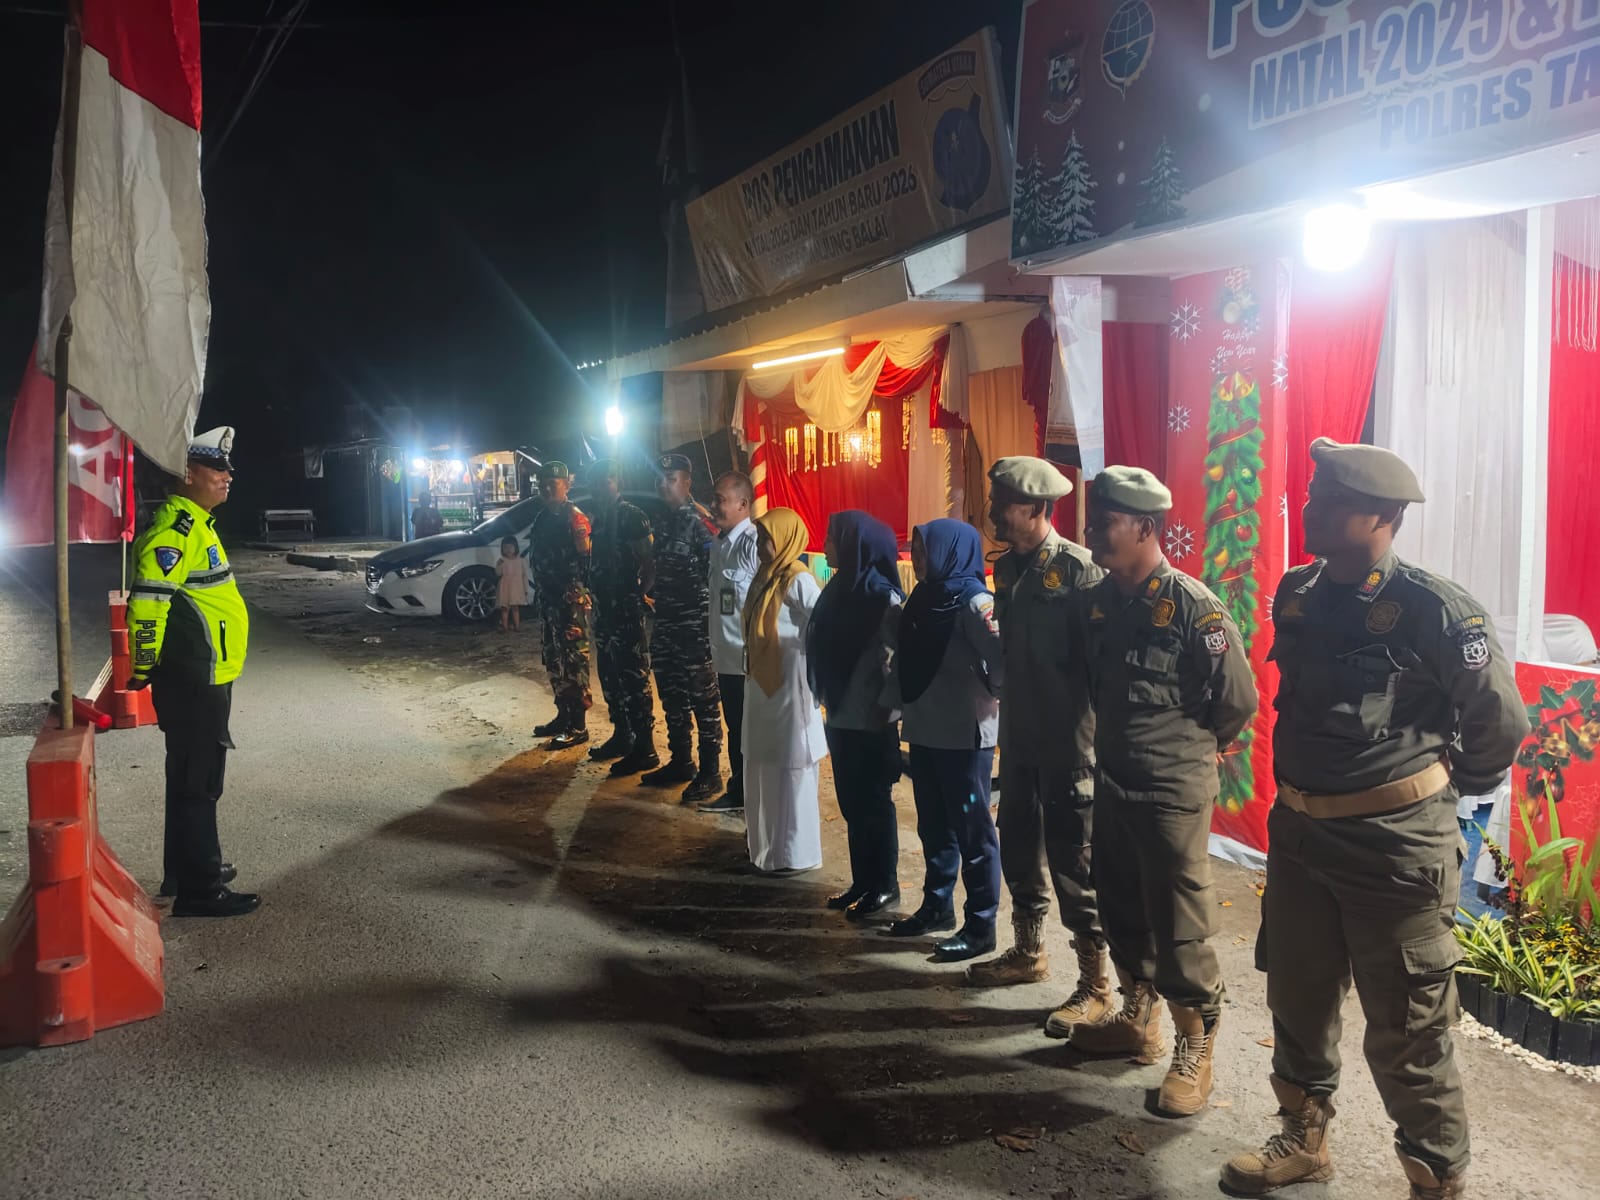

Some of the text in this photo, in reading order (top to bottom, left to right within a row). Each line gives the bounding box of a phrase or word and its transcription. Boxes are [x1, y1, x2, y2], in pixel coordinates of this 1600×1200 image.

[1251, 26, 1366, 125] NATAL
[1374, 0, 1502, 88] 2025
[1379, 66, 1533, 149] POLRES
[772, 99, 901, 208] PENGAMANAN
[790, 213, 812, 241] DAN
[811, 196, 848, 231] TAHUN
[848, 181, 881, 217] BARU
[883, 165, 918, 202] 2026
[852, 214, 889, 249] BALAI
[1222, 329, 1250, 342] Happy
[1235, 344, 1257, 359] Year
[135, 619, 156, 666] POLISI
